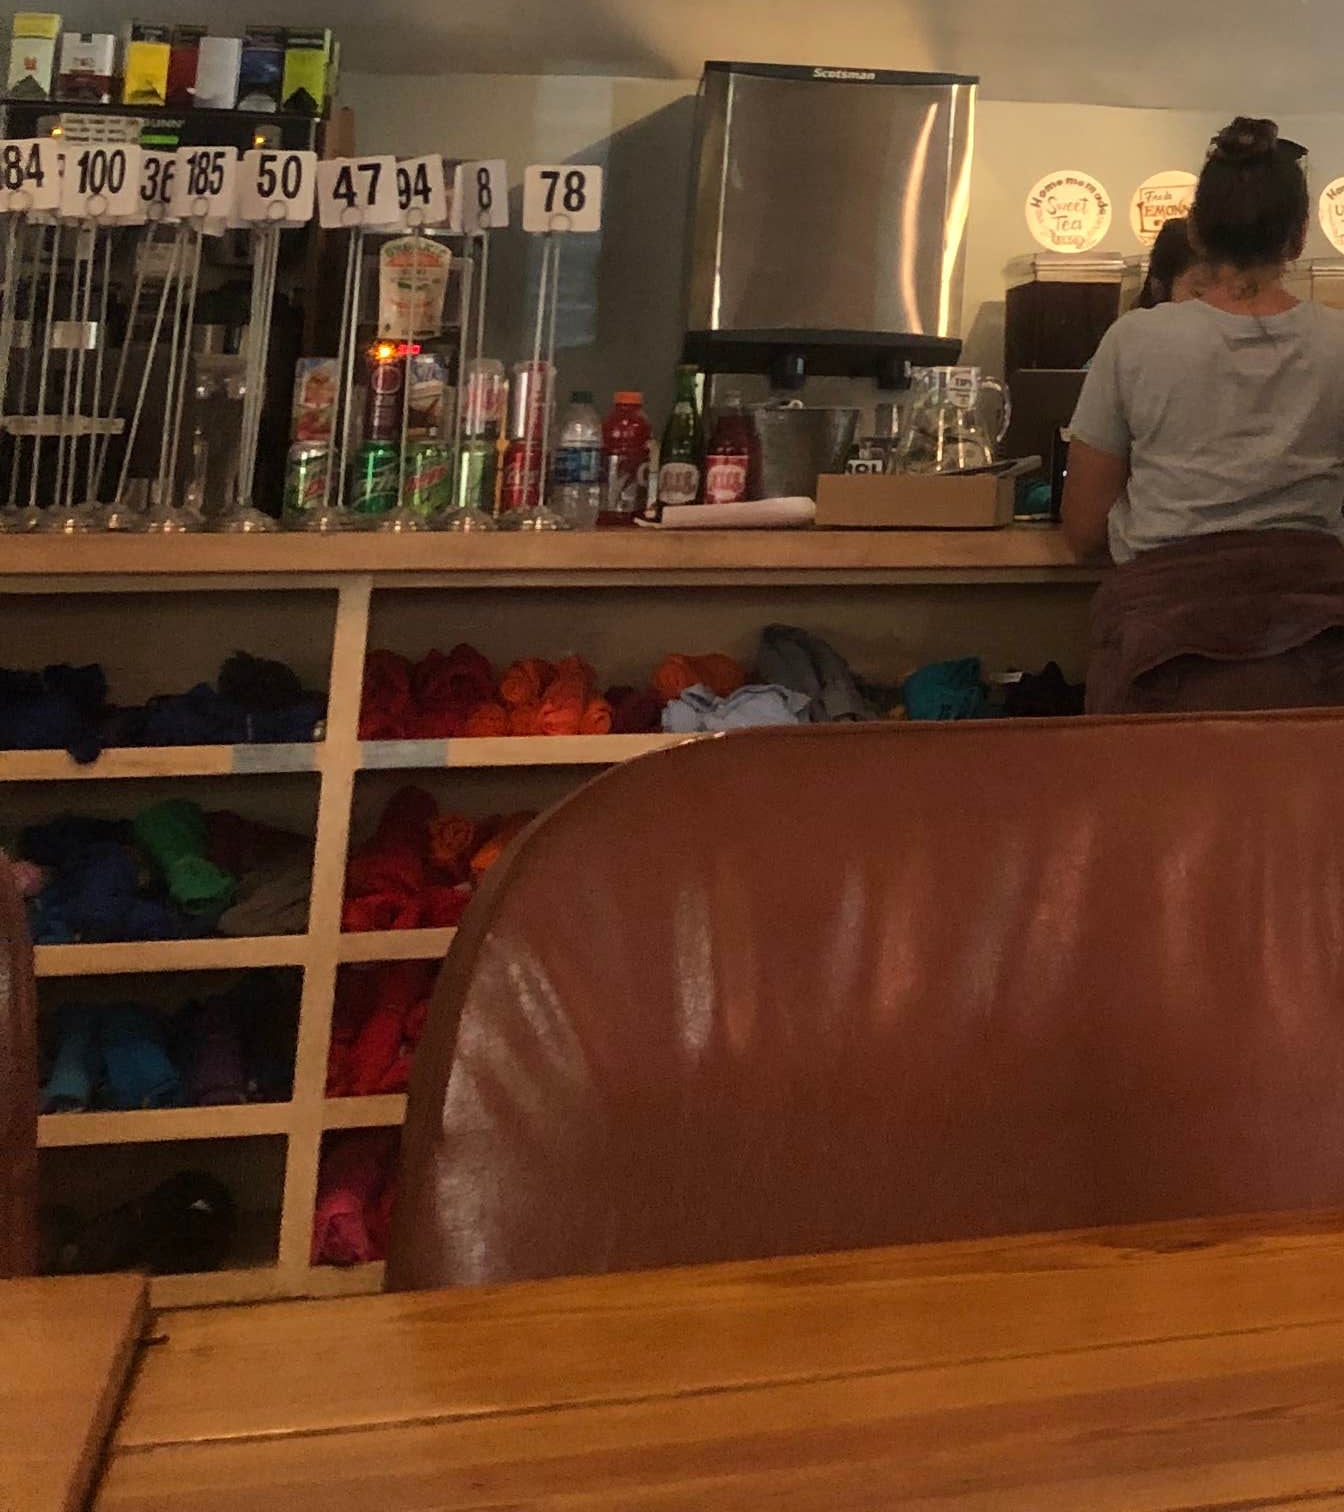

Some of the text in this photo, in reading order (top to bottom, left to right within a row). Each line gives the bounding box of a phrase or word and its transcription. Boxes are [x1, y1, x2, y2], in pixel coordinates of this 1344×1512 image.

[812, 67, 876, 81] Scotsman
[77, 148, 126, 195] 100
[186, 151, 226, 196] 185
[256, 154, 302, 200] 50
[333, 163, 381, 207] 47
[540, 170, 587, 213] 78
[1047, 196, 1089, 216] Sweet
[1050, 214, 1083, 231] Tea
